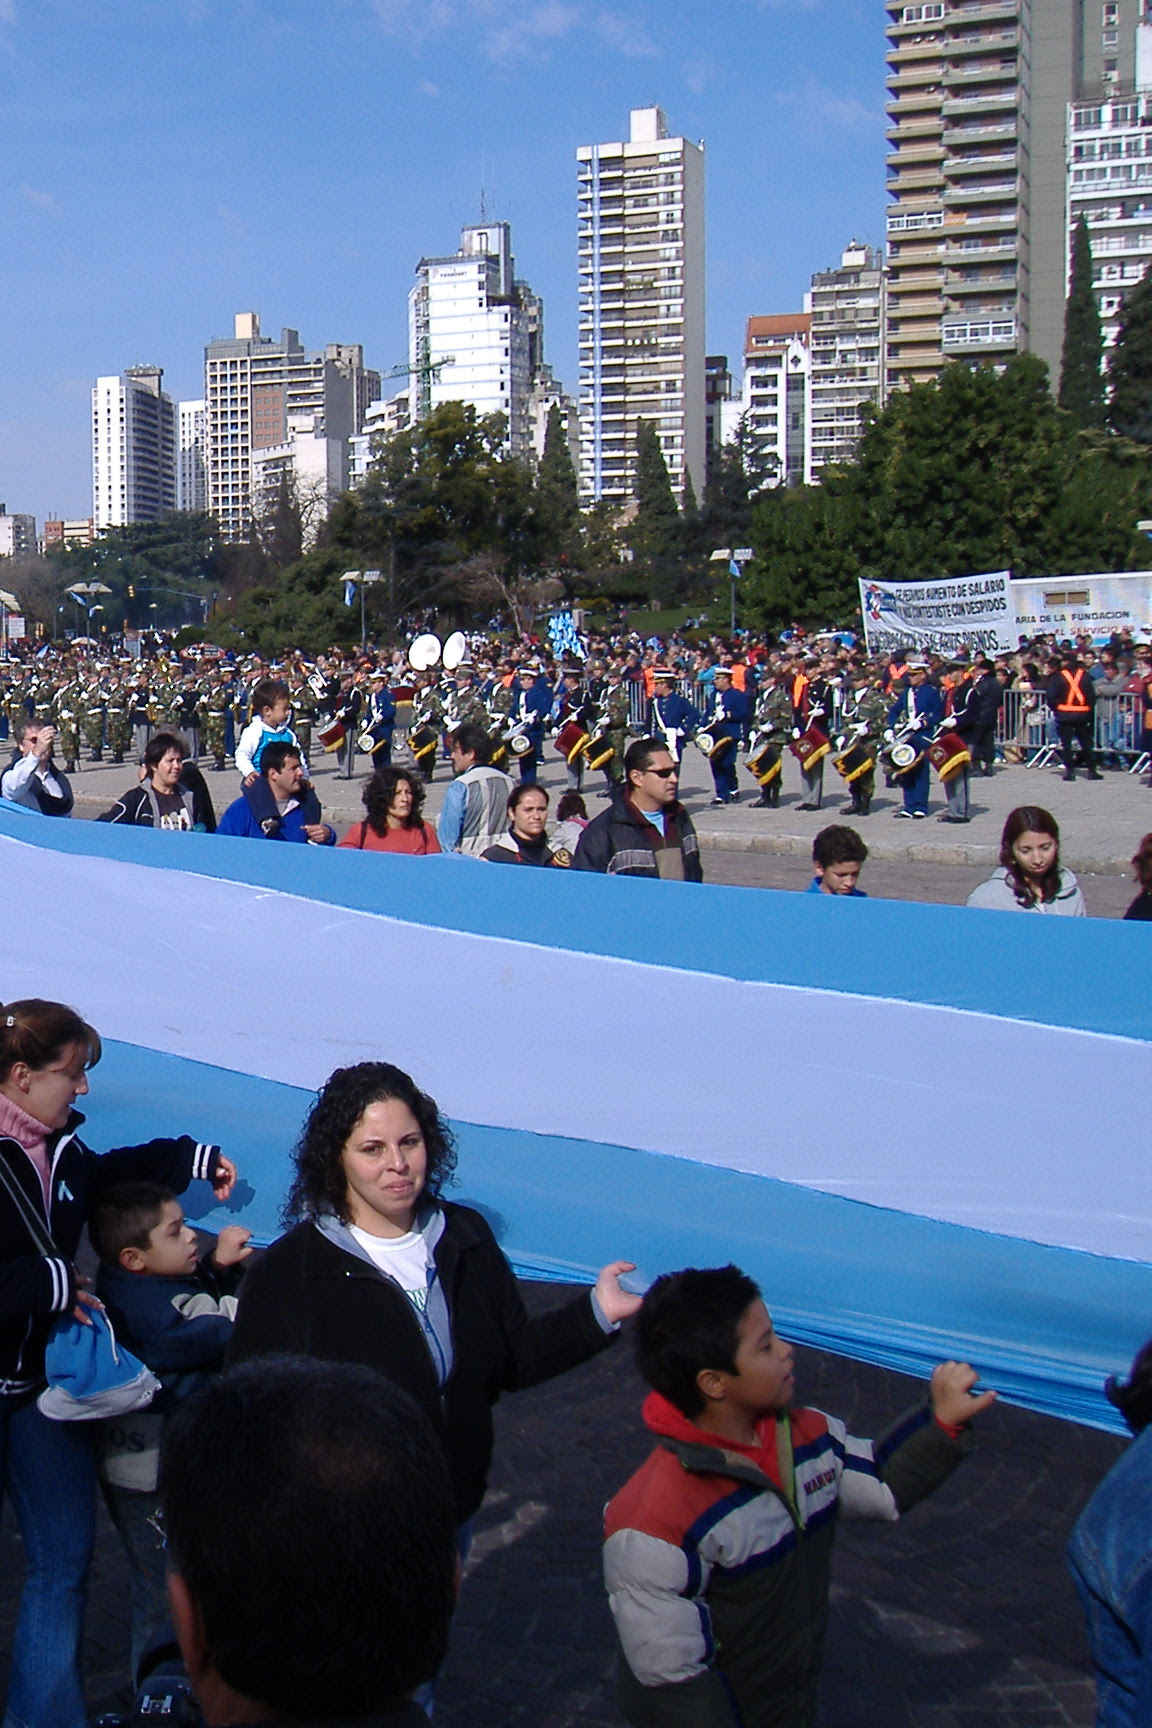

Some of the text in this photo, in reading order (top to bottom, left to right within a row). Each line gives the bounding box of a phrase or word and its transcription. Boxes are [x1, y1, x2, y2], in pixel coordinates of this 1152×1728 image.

[926, 585, 956, 600] AUMENTO
[957, 583, 967, 598] DE
[968, 579, 1005, 597] SALARIO
[952, 602, 965, 617] CON
[965, 597, 1007, 615] DESPIDOS
[1039, 615, 1052, 623] DE
[1053, 614, 1066, 622] LA
[1071, 611, 1130, 621] FUNDACION
[1070, 625, 1118, 636] SERVICIO
